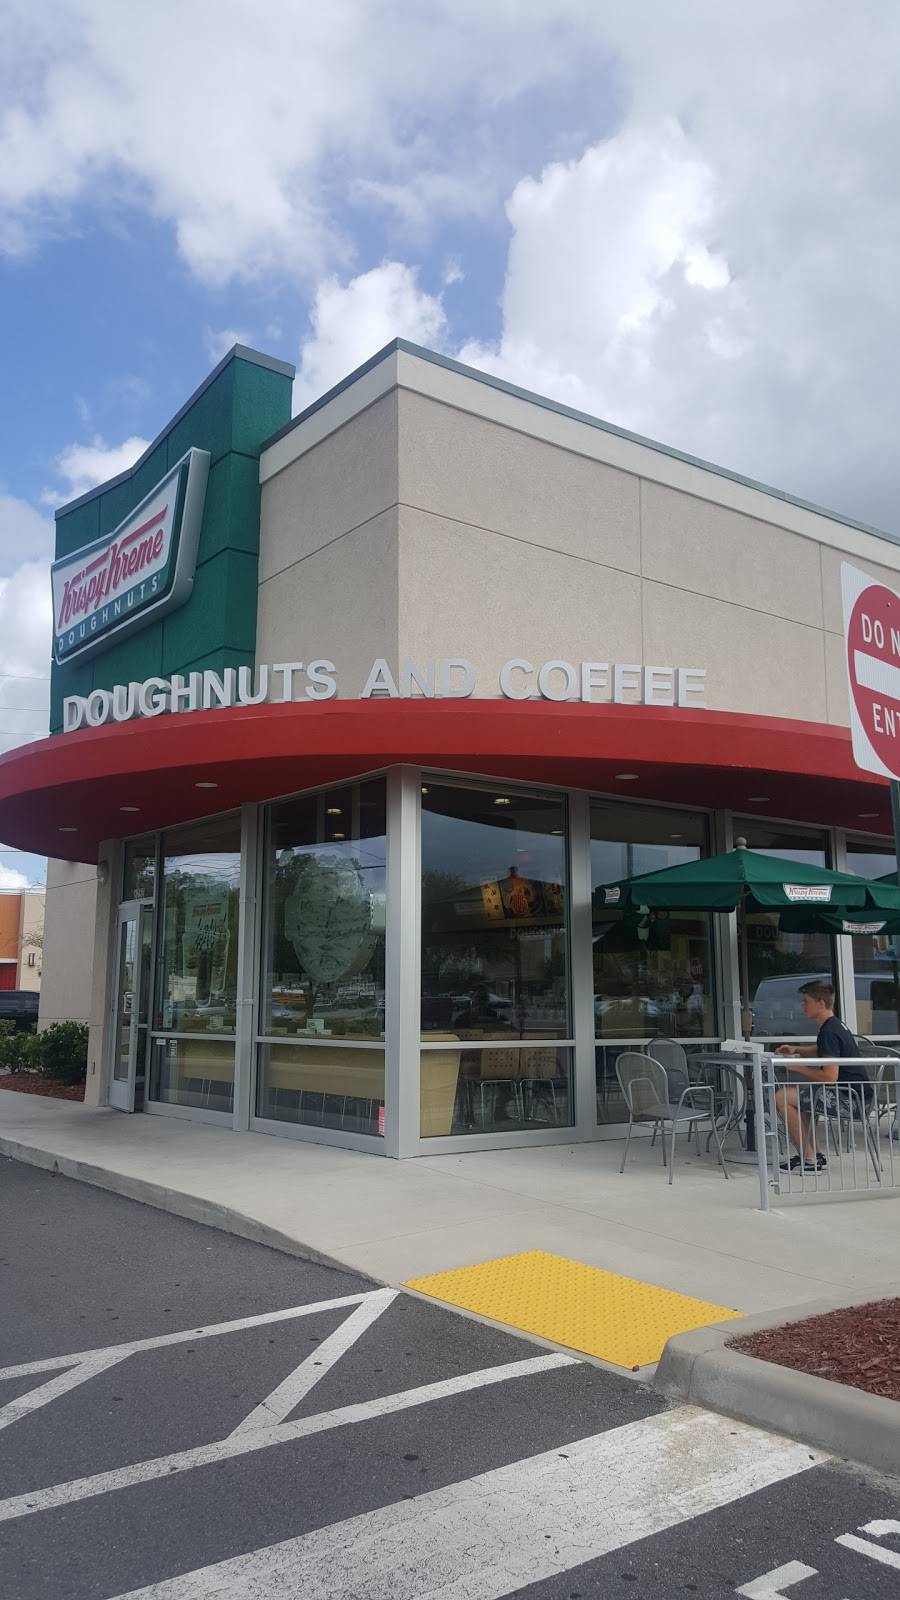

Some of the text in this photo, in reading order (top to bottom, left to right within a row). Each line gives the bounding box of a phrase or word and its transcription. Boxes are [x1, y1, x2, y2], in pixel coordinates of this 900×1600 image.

[58, 504, 168, 629] Krispy Kreme
[59, 576, 158, 651] DOUGHNUTS
[861, 613, 884, 649] DO
[63, 657, 707, 733] DOUGHNUTS AND COFFEE
